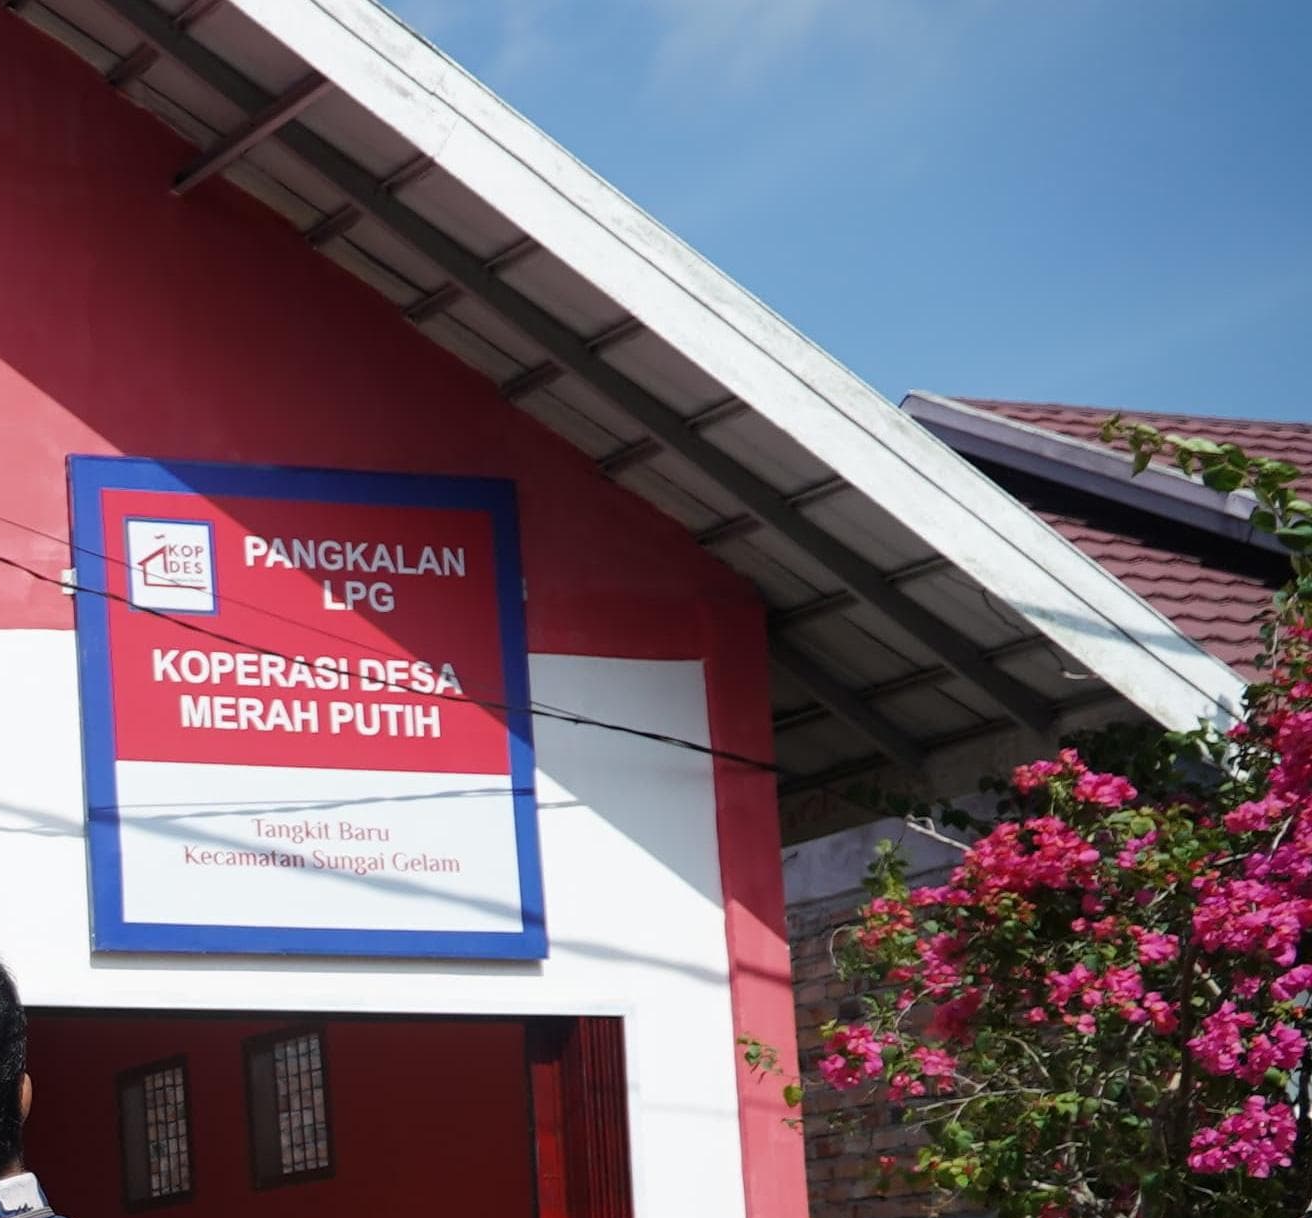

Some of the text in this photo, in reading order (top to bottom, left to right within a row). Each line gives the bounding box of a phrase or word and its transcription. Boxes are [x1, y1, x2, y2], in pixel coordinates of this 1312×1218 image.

[169, 544, 204, 558] KOP
[244, 536, 465, 576] PANGKALAN
[170, 561, 203, 574] DES
[323, 580, 395, 612] LPG
[153, 649, 463, 694] KOPERASI DESA
[180, 696, 441, 737] MERAH PUTIH
[251, 818, 390, 843] Tangkit Baru
[184, 847, 460, 874] Kecamatan Sungai Gelam
